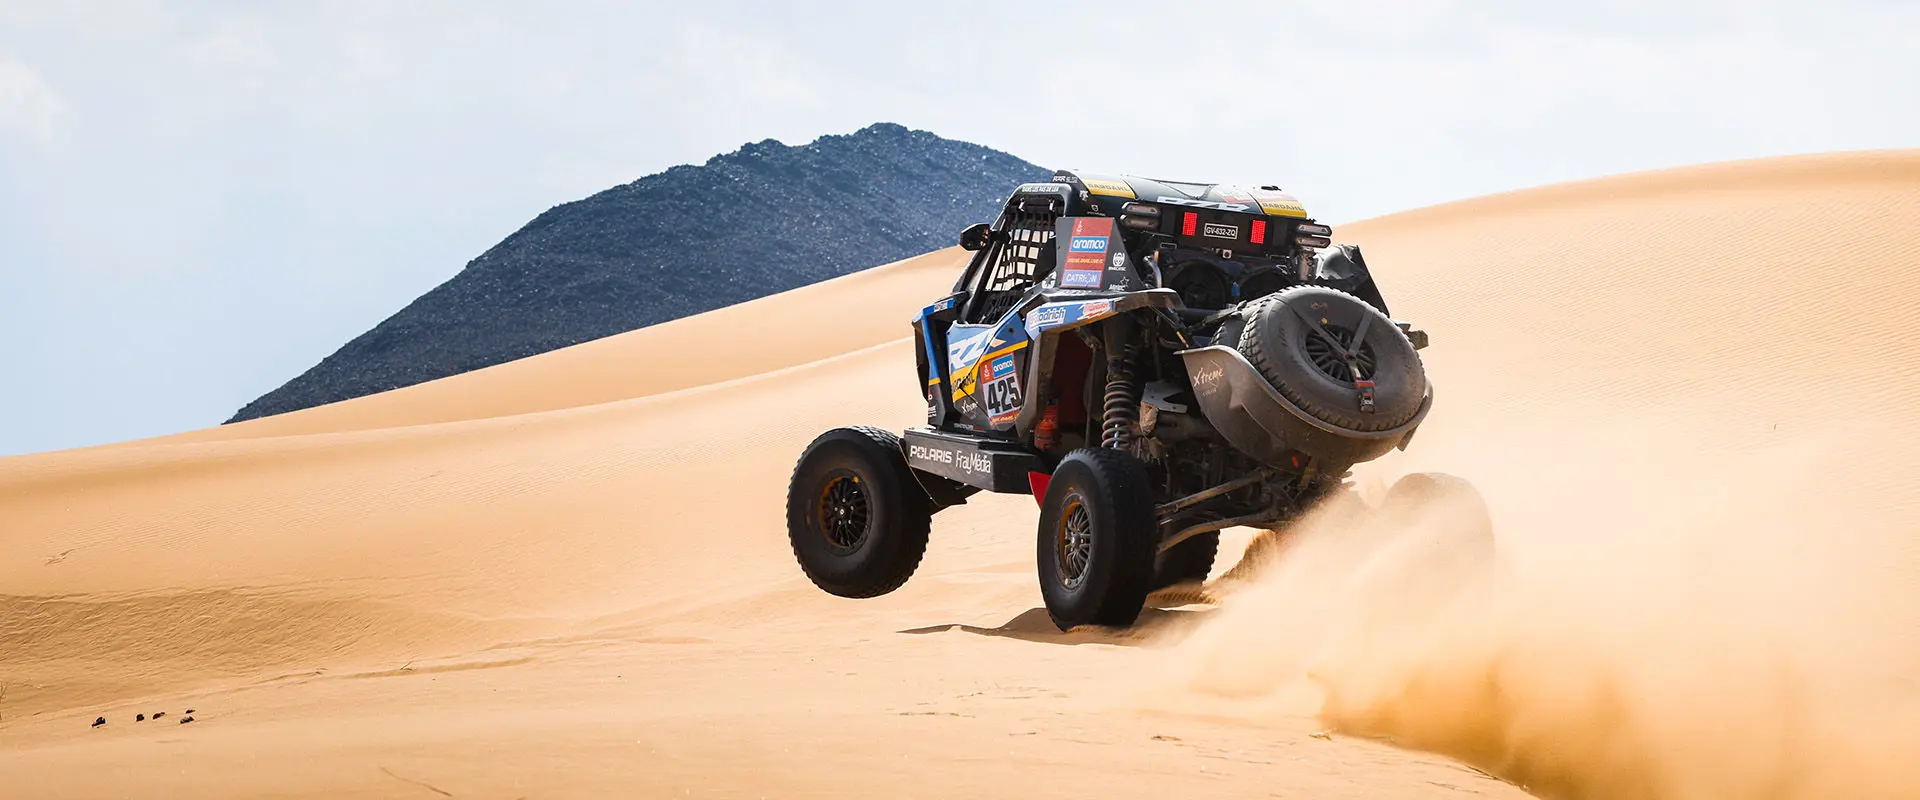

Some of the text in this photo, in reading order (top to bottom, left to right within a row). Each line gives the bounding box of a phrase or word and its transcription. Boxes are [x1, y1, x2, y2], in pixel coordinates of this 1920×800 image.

[1087, 183, 1131, 192] BARDAHL
[1262, 202, 1302, 211] BARDAHL
[1073, 240, 1105, 249] aramco
[993, 360, 1014, 373] aramco
[1193, 367, 1224, 387] Xtreme
[987, 375, 1021, 413] 425
[909, 445, 952, 463] POLARIS
